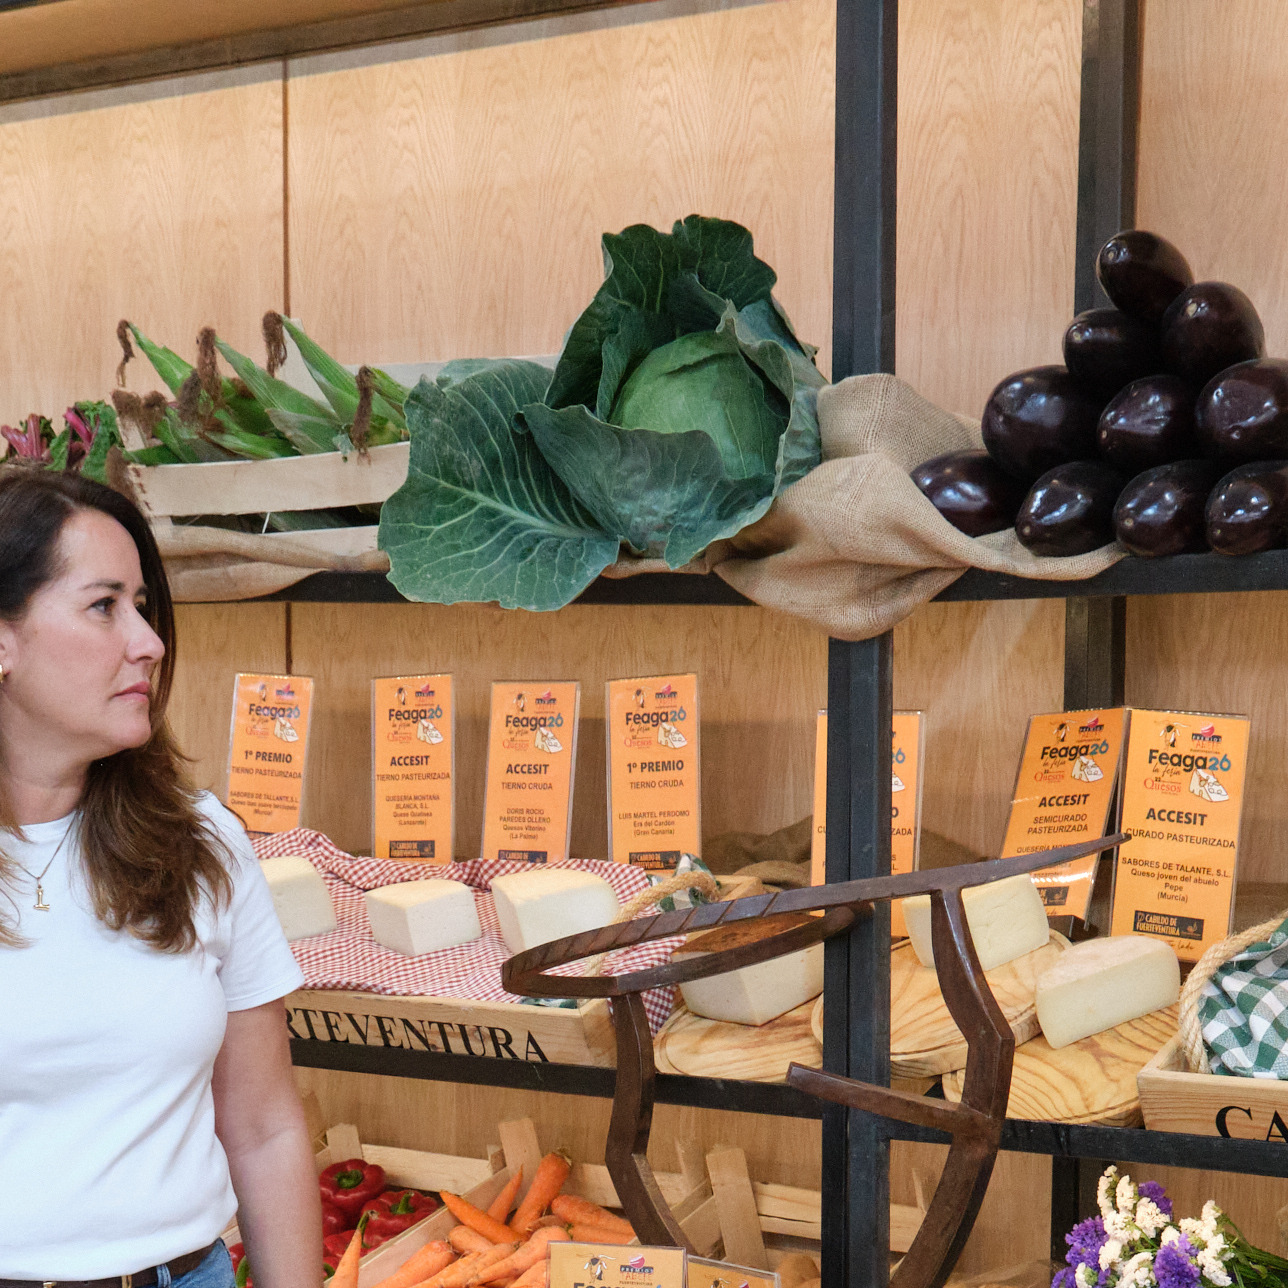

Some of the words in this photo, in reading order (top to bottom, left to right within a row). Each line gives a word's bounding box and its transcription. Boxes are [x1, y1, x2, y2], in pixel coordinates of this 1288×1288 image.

[249, 704, 300, 720] Feaga26
[389, 705, 442, 723] Feaga26
[626, 707, 686, 727] Feaga26
[505, 713, 563, 731] Feaga26
[256, 751, 292, 763] PREMIO
[1041, 740, 1109, 761] Feaga26
[390, 756, 430, 766] ACCESIT
[641, 760, 684, 772] PREMIO
[1149, 749, 1231, 772] Feaga26
[255, 769, 301, 779] PASTEURIZADA
[402, 772, 450, 780] PASTEURIZADA
[506, 764, 549, 774] ACCESIT
[630, 781, 656, 789] TIERNO
[1144, 777, 1182, 794] Quesos
[1039, 794, 1090, 807] ACCESIT
[1033, 814, 1087, 824] SEMICURADO
[1146, 808, 1207, 826] ACCESIT
[1027, 824, 1088, 835] PASTEURIZADA
[1126, 828, 1164, 840] CURADO
[1167, 833, 1235, 849] PASTEURIZADA
[1122, 857, 1160, 869] SABORES
[1163, 862, 1173, 871] DE
[1216, 869, 1231, 878] S.L.
[1131, 869, 1155, 878] Queso
[1157, 872, 1177, 882] joven
[1180, 874, 1191, 883] del
[1194, 877, 1219, 887] abuelo
[1165, 883, 1183, 892] Pepe
[1145, 914, 1169, 925] CABILDO
[1171, 917, 1177, 926] DE
[1136, 922, 1180, 937] FUERTEVENTURA
[285, 1007, 549, 1062] RTEVENTURA
